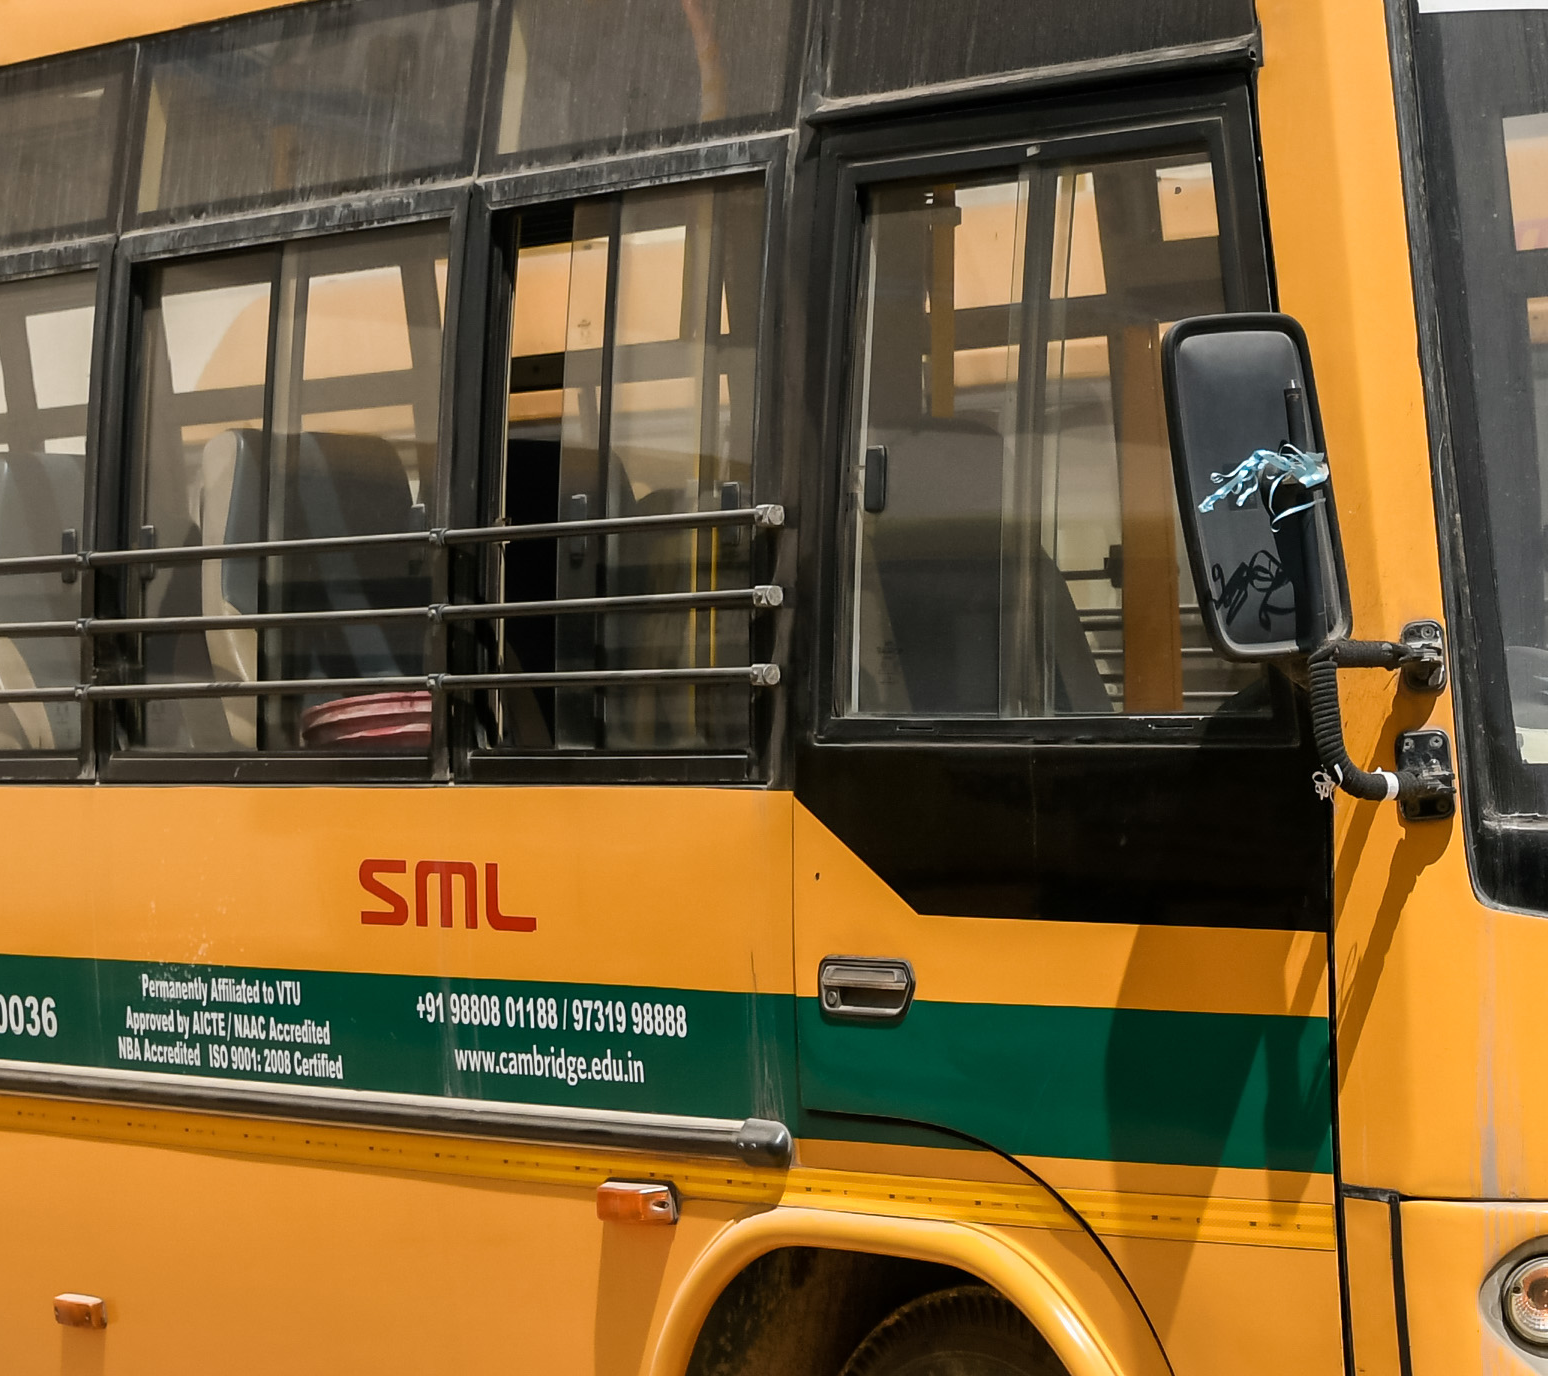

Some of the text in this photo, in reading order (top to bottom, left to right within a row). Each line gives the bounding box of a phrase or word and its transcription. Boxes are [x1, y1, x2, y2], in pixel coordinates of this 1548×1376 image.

[358, 859, 537, 932] SML
[142, 974, 301, 1006] Permanently Affiliated to VTU
[126, 1006, 175, 1036] Approved
[177, 1009, 190, 1039] by
[193, 1011, 226, 1037] AICTE
[234, 1014, 266, 1040] NAAC
[269, 1017, 331, 1045] Accredited
[416, 992, 687, 1038] +91 98808 01188 / 97319 98888
[118, 1036, 344, 1079] NBA Accredited ISO 9001: 2008 Certified
[454, 1044, 645, 1086] www.cambridge.edu.in
